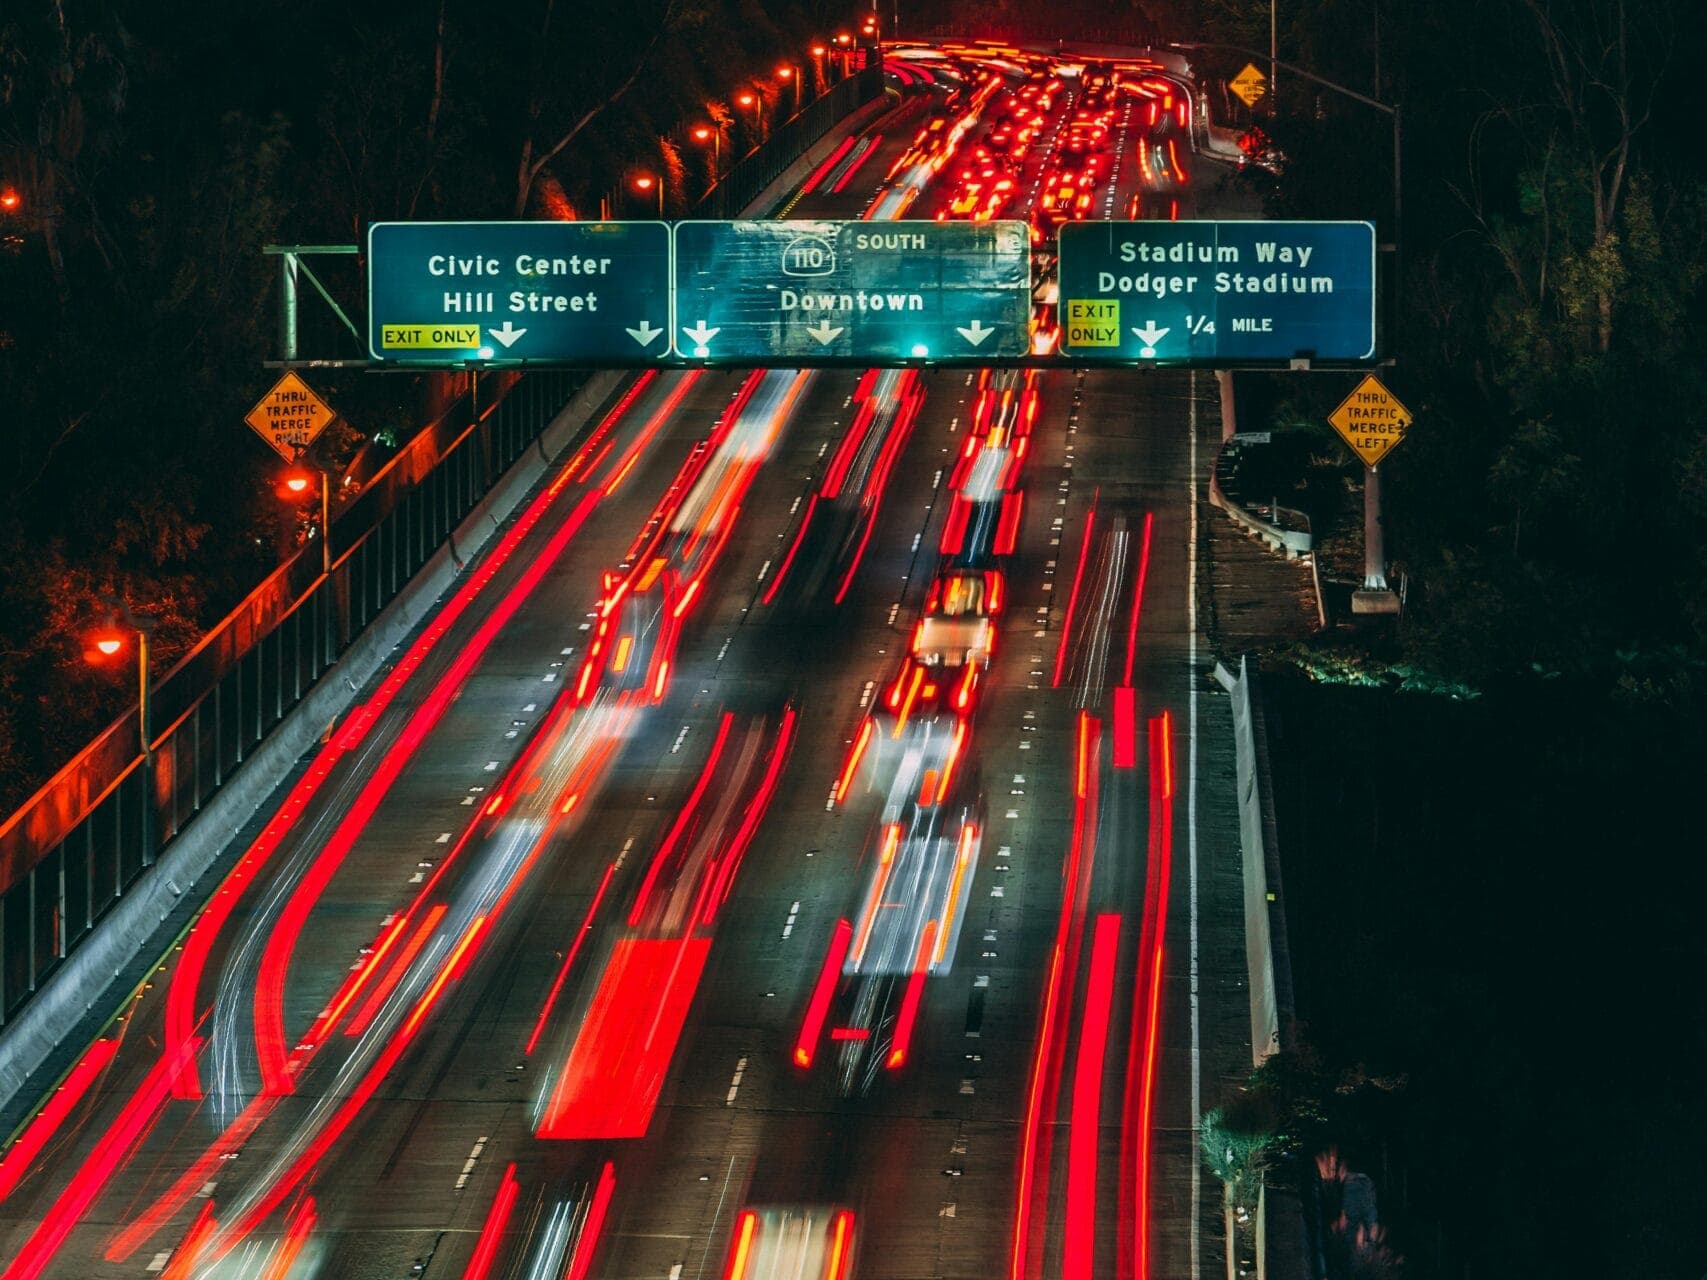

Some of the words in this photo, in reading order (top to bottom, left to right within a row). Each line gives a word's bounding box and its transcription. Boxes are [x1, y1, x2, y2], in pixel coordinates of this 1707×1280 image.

[855, 234, 926, 251] SOUTH
[795, 248, 823, 268] 110
[1121, 241, 1239, 263] Stadium
[1256, 242, 1313, 268] Way
[429, 255, 500, 276] Civic
[516, 255, 611, 276] Center
[1098, 272, 1198, 300] Dodger
[1214, 272, 1333, 293] Stadium
[443, 292, 493, 313] Hill
[509, 292, 597, 313] Street
[780, 290, 923, 311] Downtown
[1072, 305, 1117, 318] EXIT
[1232, 318, 1273, 332] MILE
[385, 330, 424, 344] EXIT
[432, 330, 477, 344] ONLY
[1071, 328, 1117, 341] ONLY
[275, 392, 308, 403] THRU
[1357, 393, 1388, 404] THRU
[266, 405, 317, 417] TRAFFIC
[1347, 408, 1397, 419] TRAFFIC
[271, 419, 311, 430] MERGE
[1349, 423, 1396, 434] MERGE
[1356, 438, 1389, 449] LEFT
